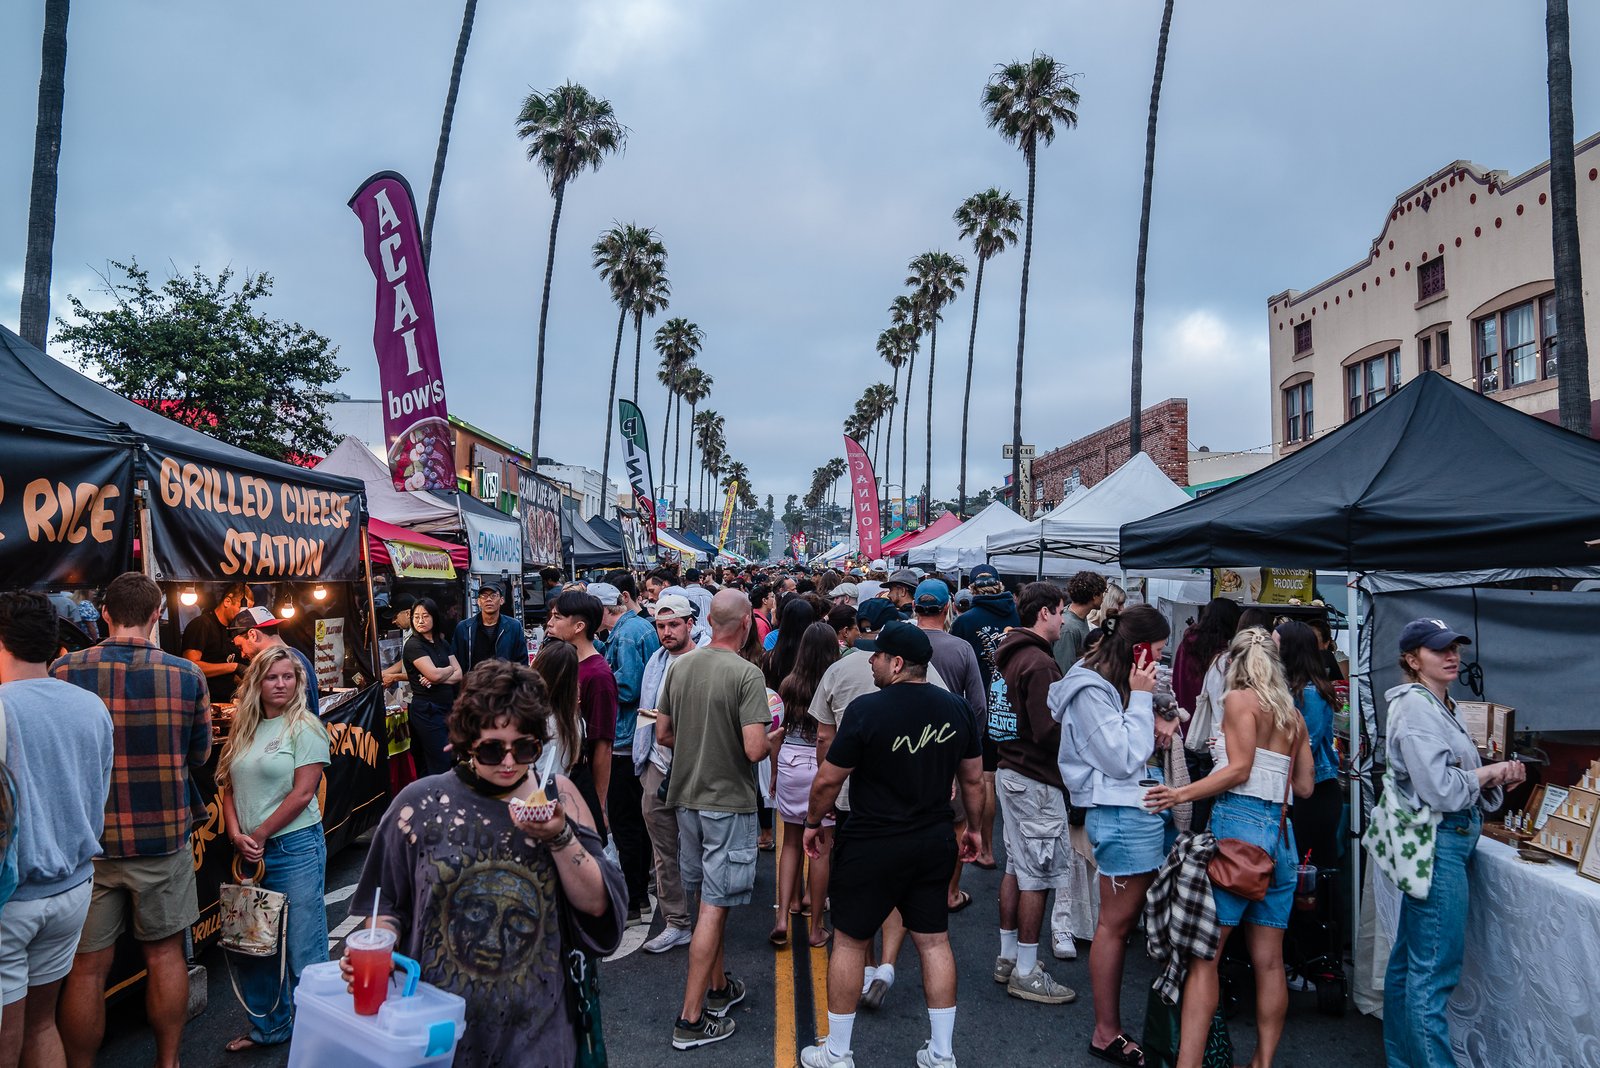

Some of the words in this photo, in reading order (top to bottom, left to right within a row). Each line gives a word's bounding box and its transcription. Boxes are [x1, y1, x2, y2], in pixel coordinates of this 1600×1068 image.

[373, 188, 423, 376] ACAI
[388, 374, 444, 420] bowls
[23, 477, 120, 544] RICE
[160, 457, 273, 520] GRILLED
[281, 483, 351, 529] CHEESE
[220, 527, 325, 576] STATION
[478, 531, 520, 563] EMPANADAS
[1273, 578, 1304, 590] PRODUCTS
[326, 721, 379, 769] STATION
[704, 1022, 718, 1037] N
